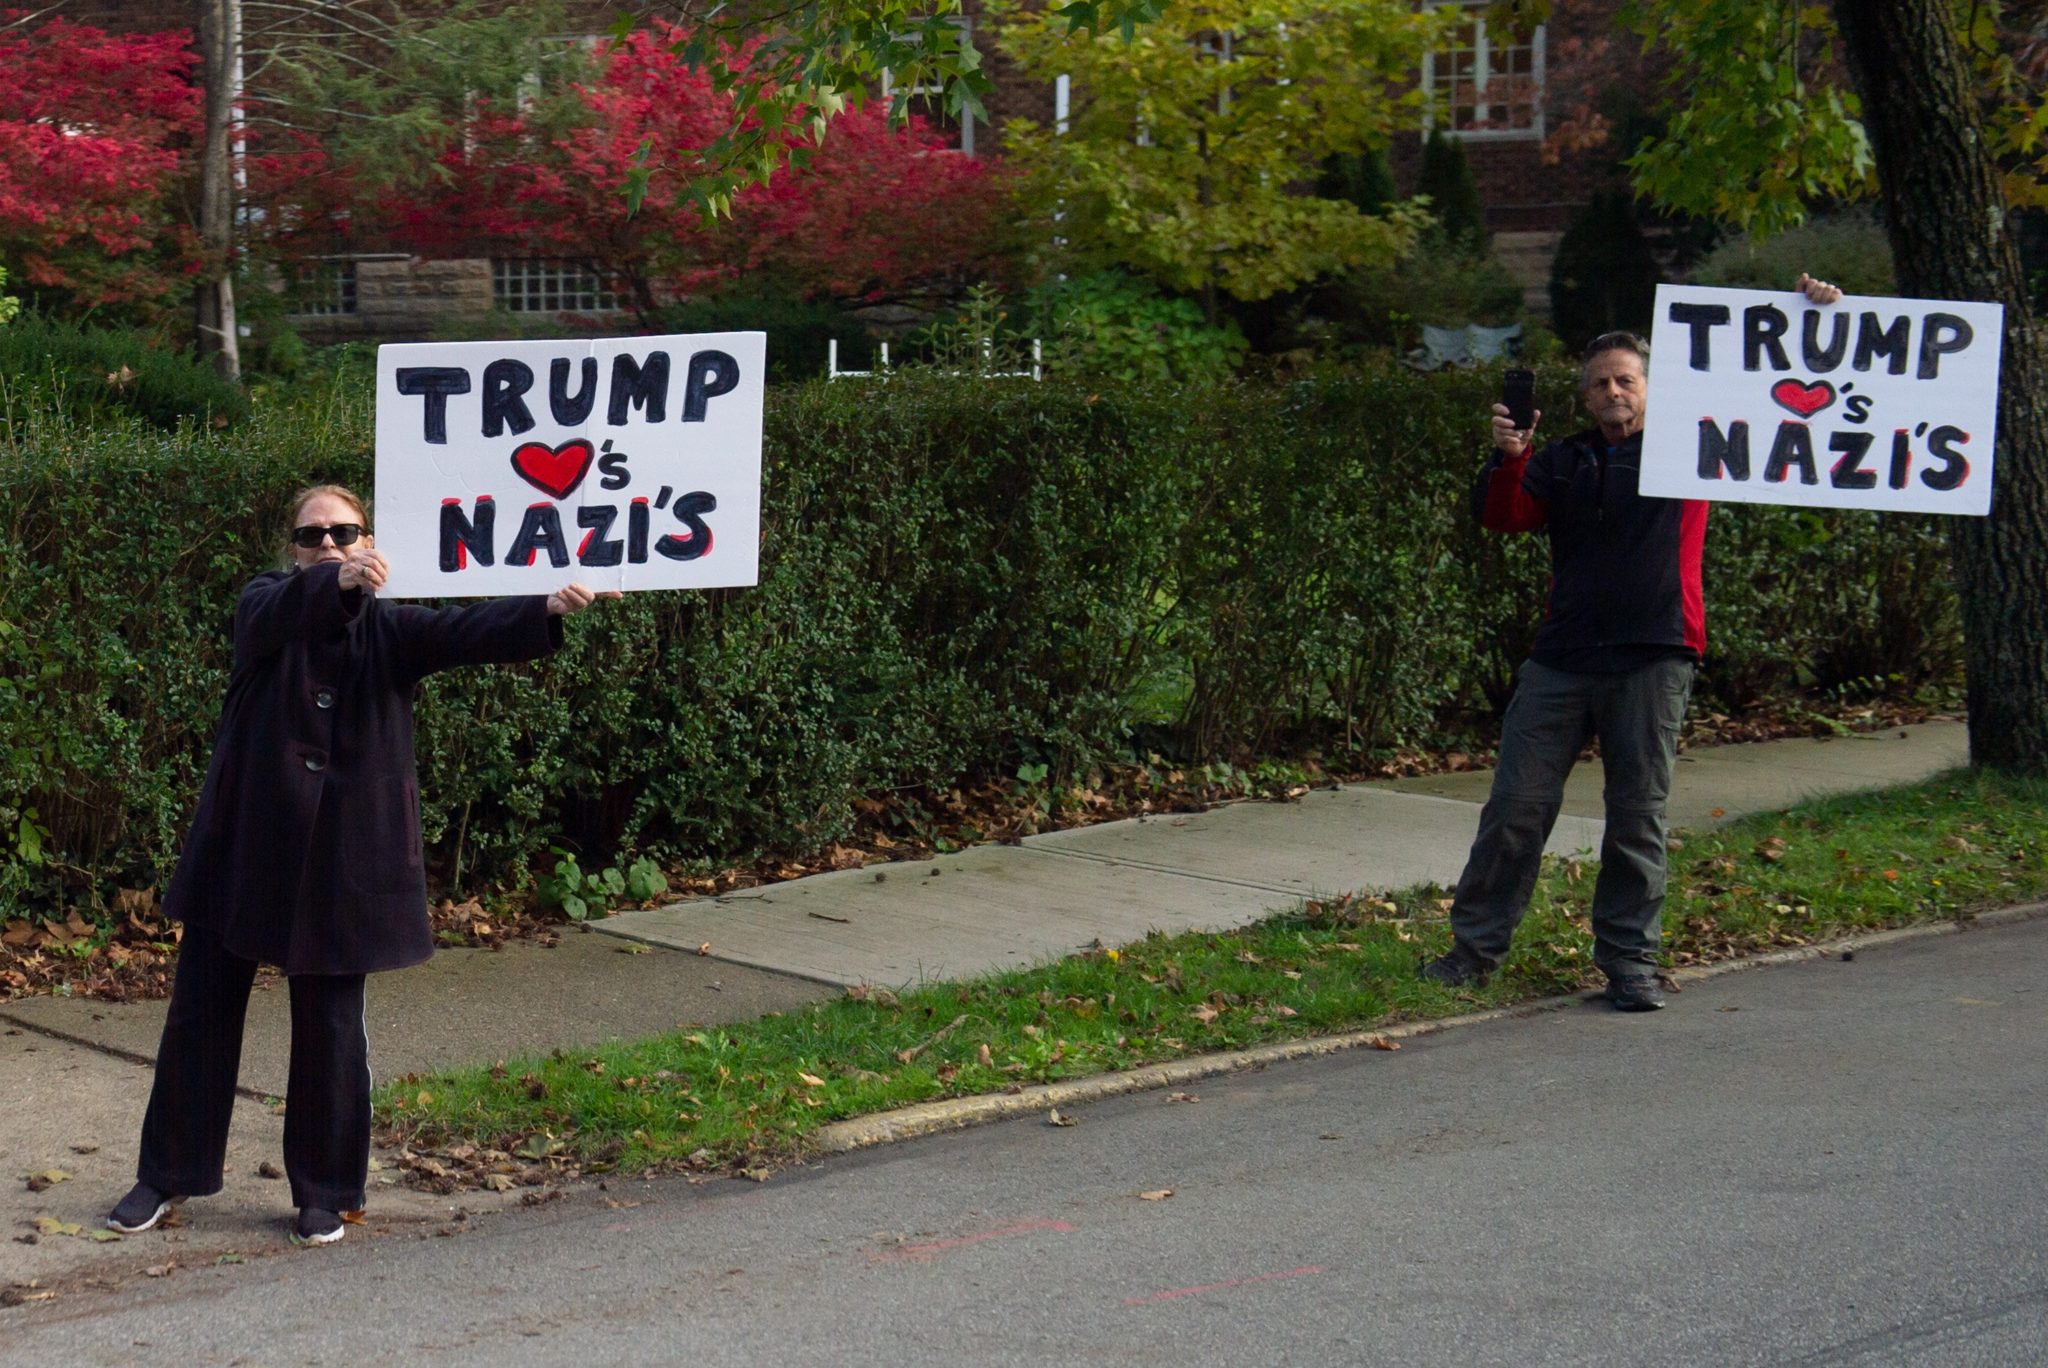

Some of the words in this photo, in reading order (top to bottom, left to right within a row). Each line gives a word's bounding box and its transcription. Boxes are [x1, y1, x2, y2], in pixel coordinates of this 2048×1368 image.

[1669, 302, 1974, 380] TRUMP
[395, 350, 740, 444] TRUMP
[1697, 416, 1971, 492] NAZI'S
[438, 485, 717, 573] NAZI'S
